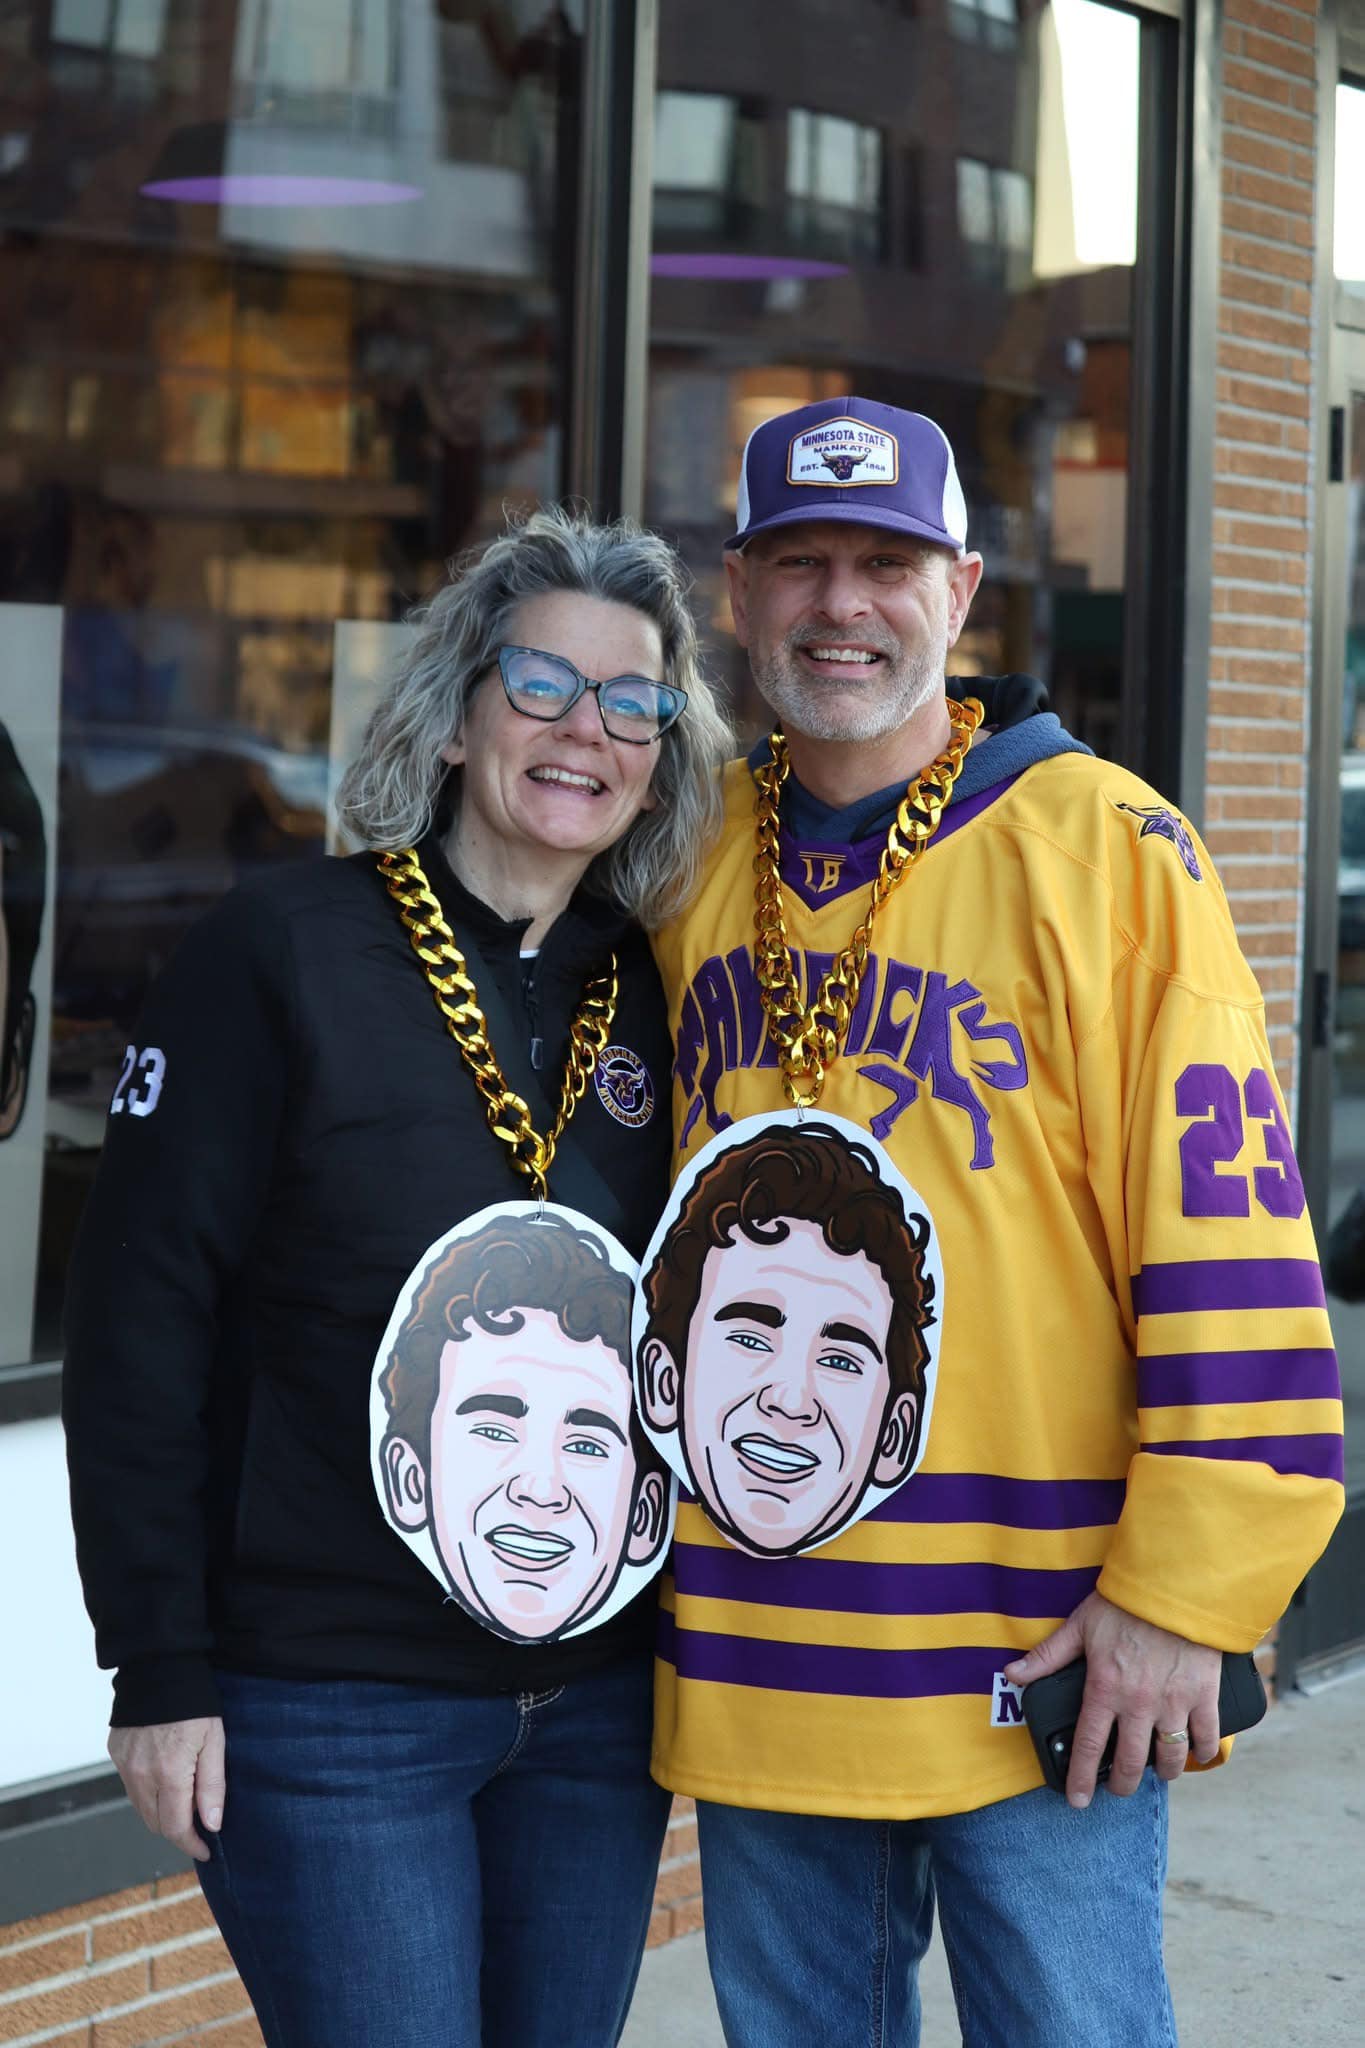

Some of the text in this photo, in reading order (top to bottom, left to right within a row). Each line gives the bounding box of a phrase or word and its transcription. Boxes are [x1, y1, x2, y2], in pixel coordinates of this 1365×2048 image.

[801, 429, 886, 448] MINNESOTA STATE
[813, 443, 872, 454] MANKATO
[599, 1046, 641, 1067] HOCKEY
[109, 1044, 167, 1118] 23
[1174, 1063, 1307, 1220] 23
